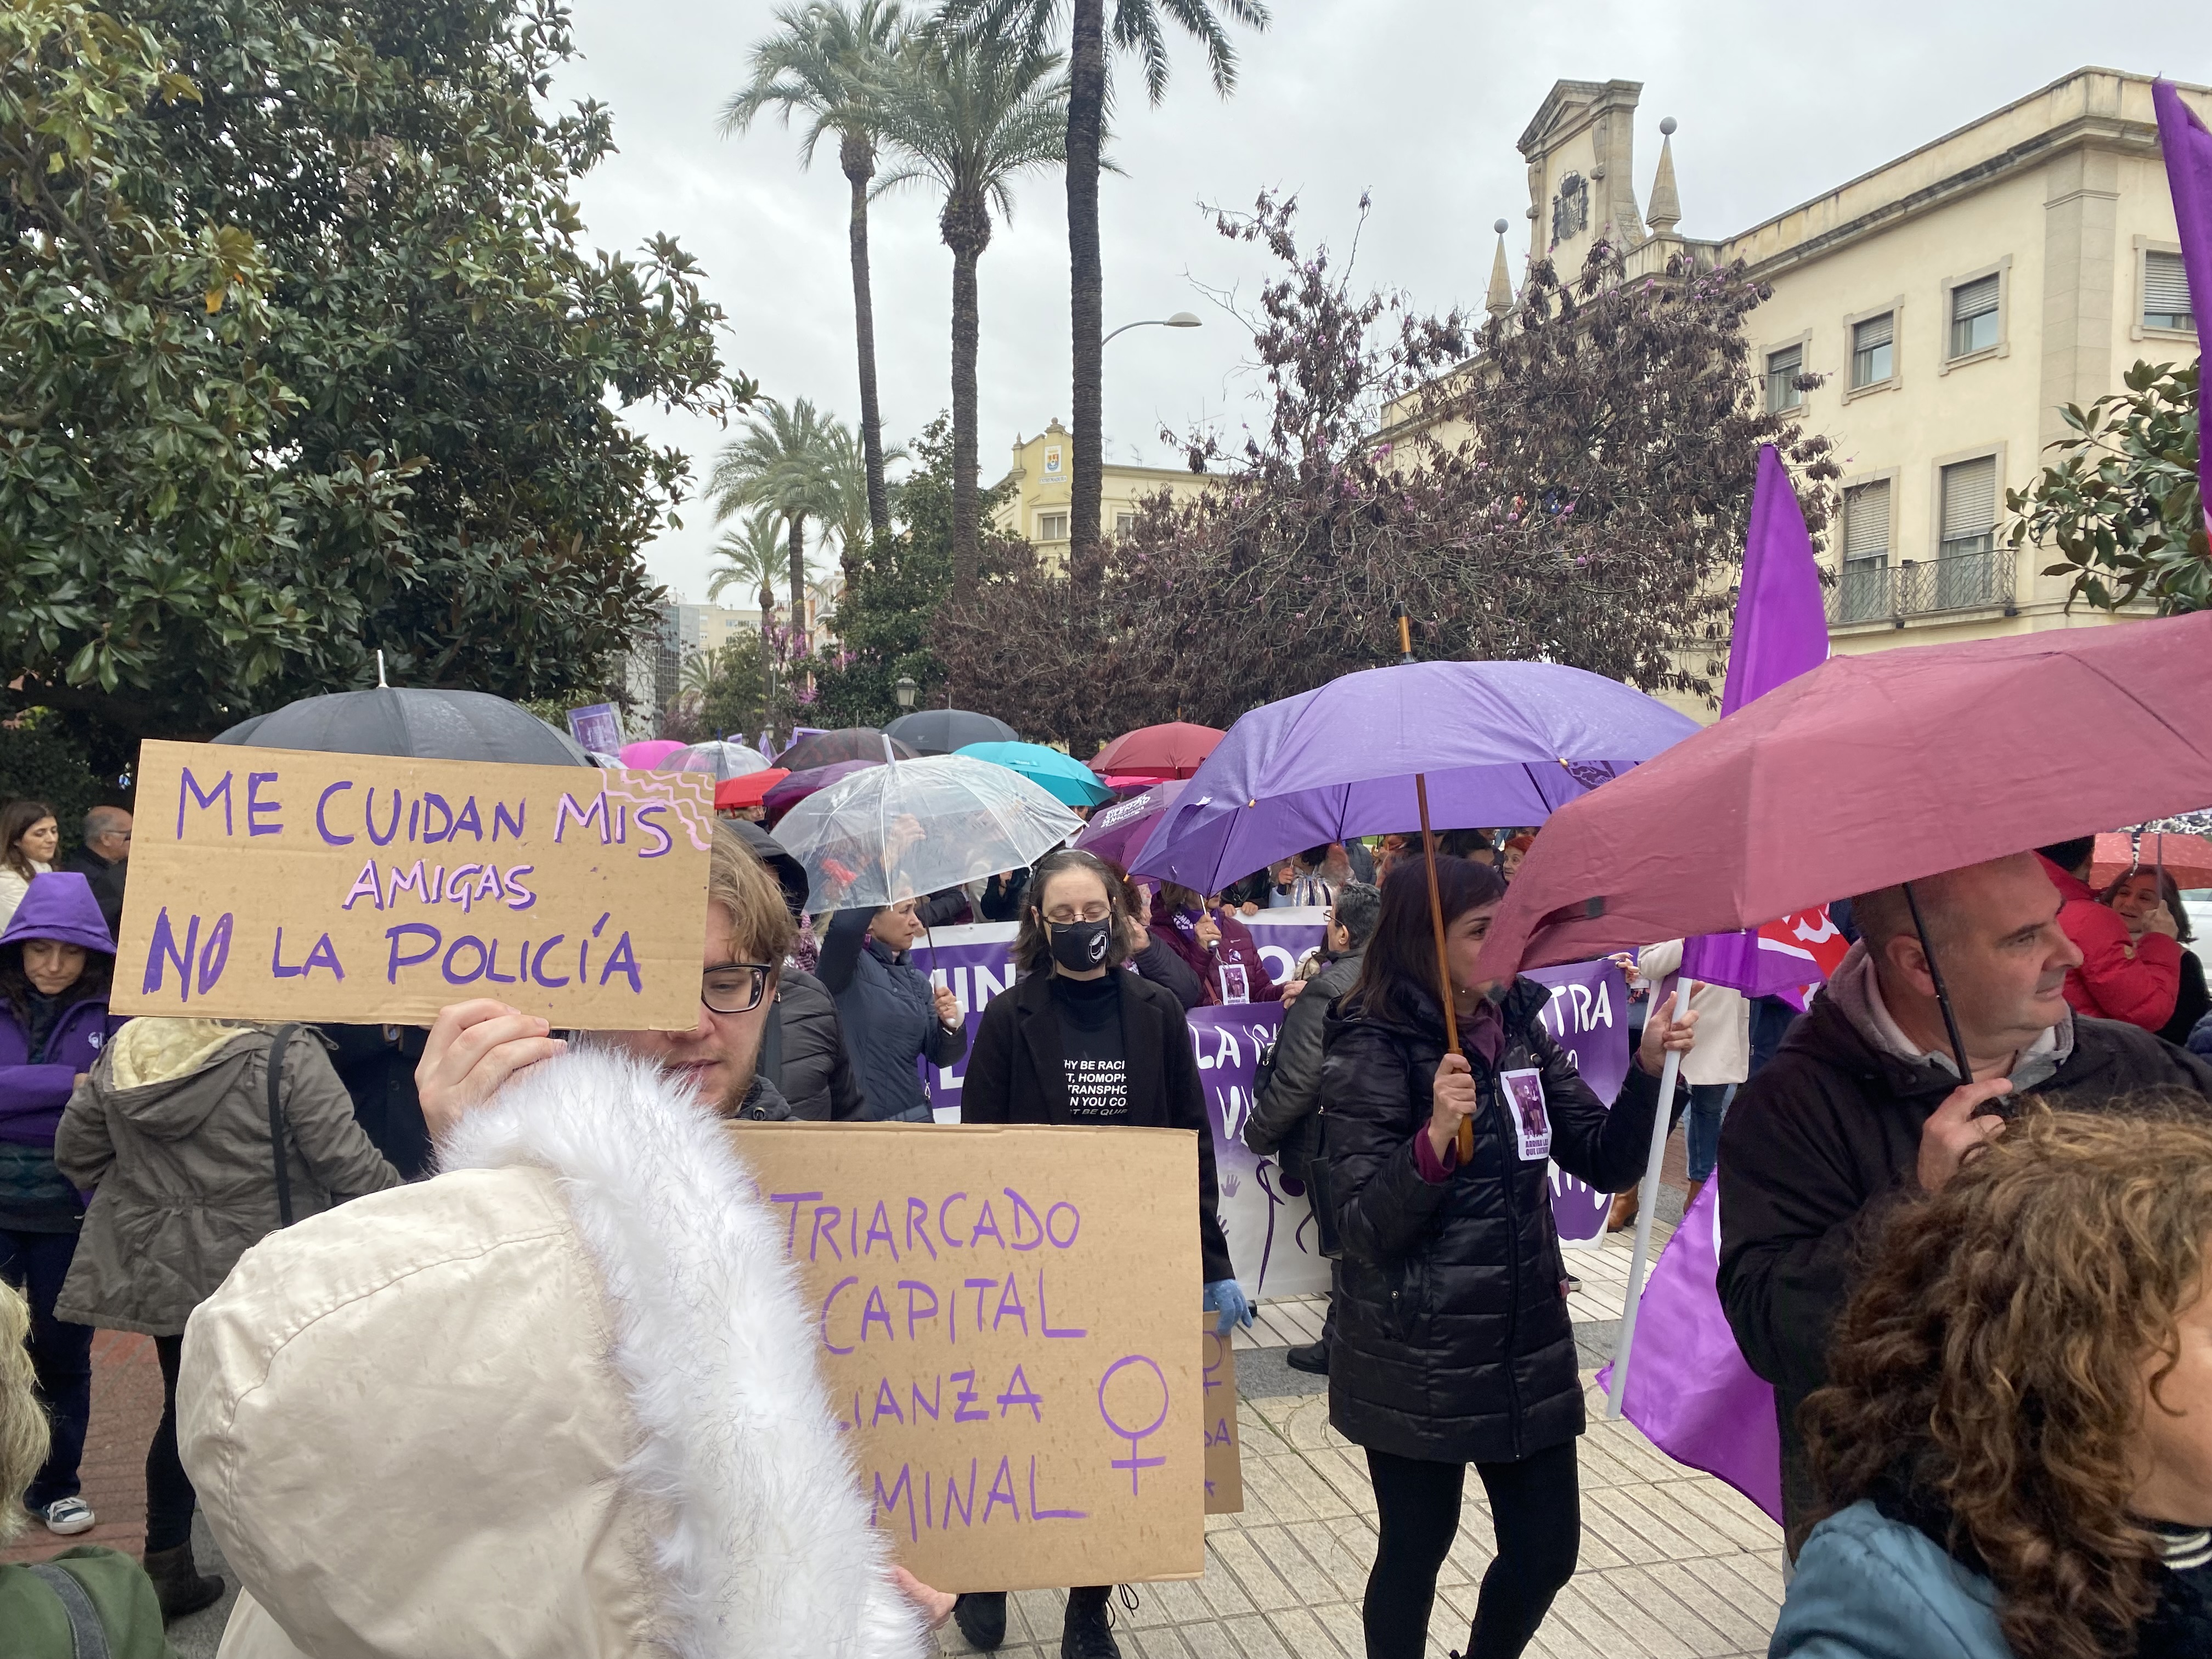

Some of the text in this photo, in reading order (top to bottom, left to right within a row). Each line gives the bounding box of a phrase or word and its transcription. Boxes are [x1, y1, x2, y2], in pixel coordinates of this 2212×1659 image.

[178, 767, 673, 857] ME CUIDAN MIS
[342, 859, 537, 912] AMIGAS
[143, 906, 642, 1002] NO LA POLICÍA
[1064, 1059, 1078, 1070] HY
[1080, 1060, 1096, 1070] BE
[1066, 1073, 1075, 1083] T,
[1188, 1023, 1241, 1069] LA
[1070, 1097, 1127, 1107] N YOU CO
[770, 1187, 1080, 1262] TRIARCADO
[820, 1268, 1087, 1355] CAPITAL
[854, 1364, 1042, 1429] IANZA
[870, 1455, 1090, 1543] MINAL
